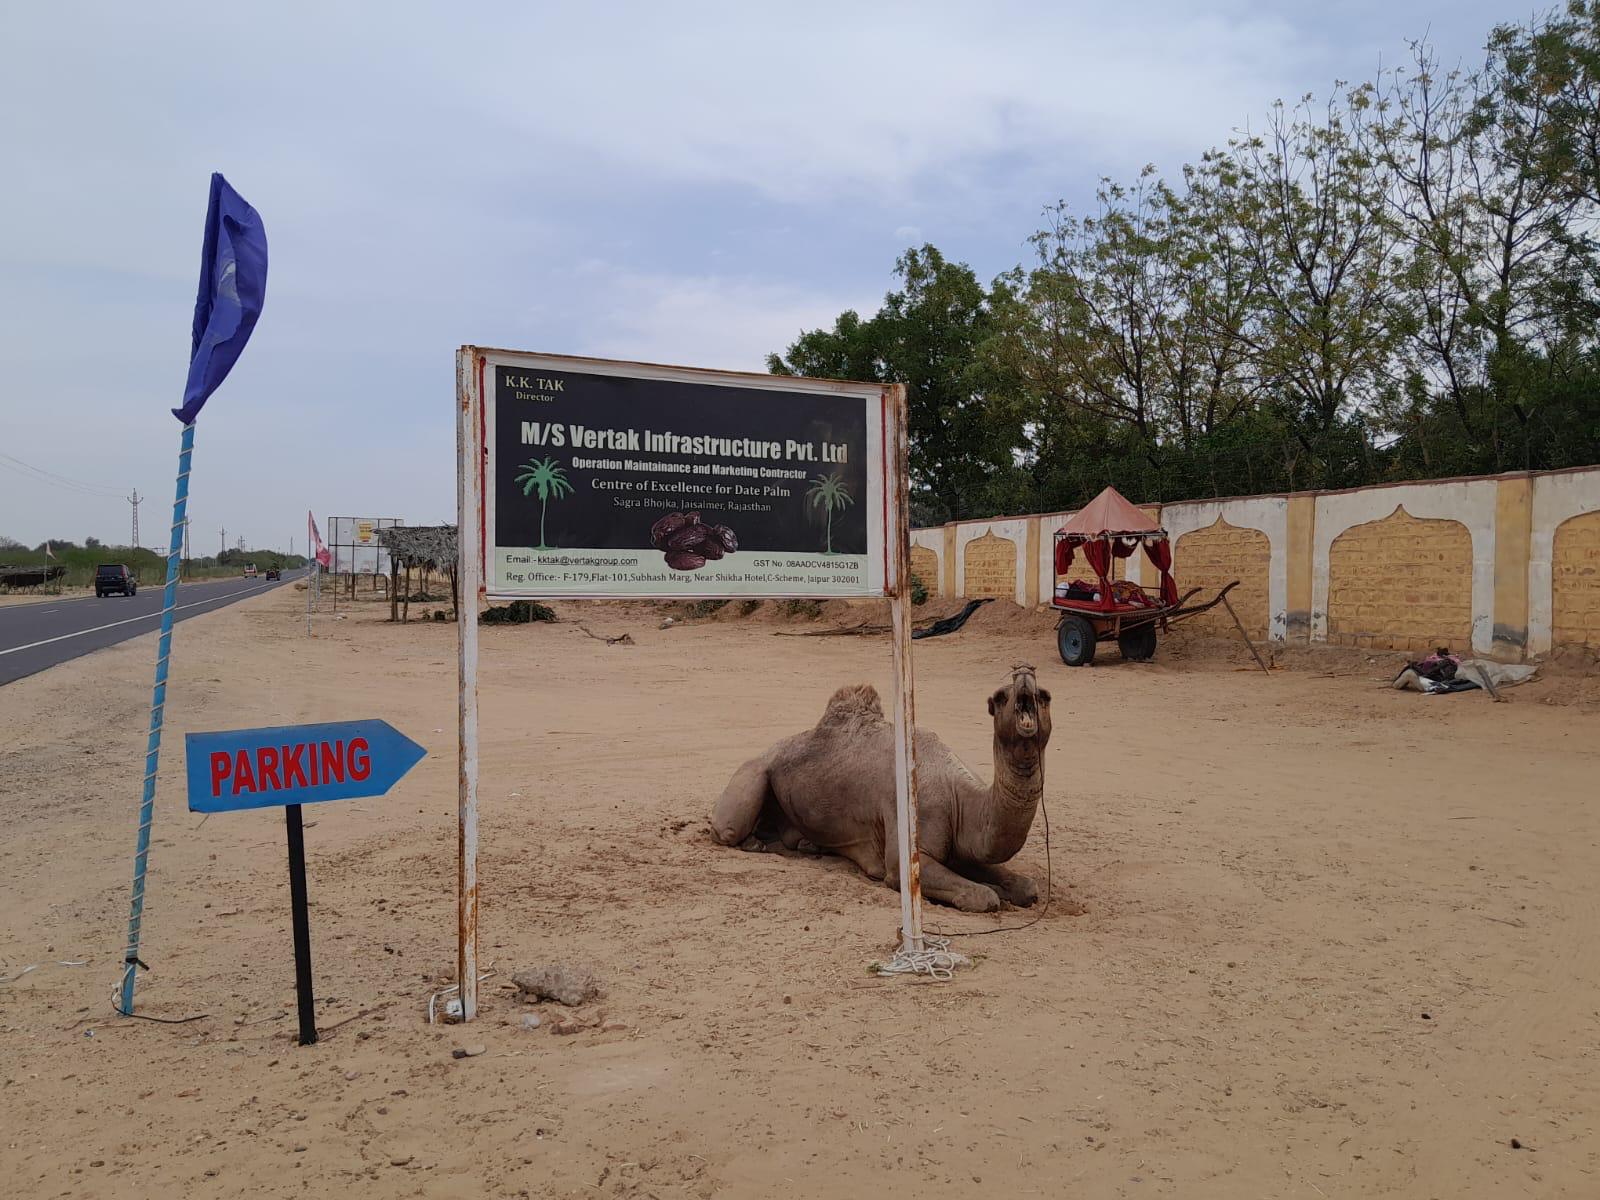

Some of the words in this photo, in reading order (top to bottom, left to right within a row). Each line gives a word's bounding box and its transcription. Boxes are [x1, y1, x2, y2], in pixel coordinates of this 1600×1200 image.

[506, 376, 532, 388] K.K.
[536, 378, 564, 391] TAK
[516, 392, 555, 402] Director
[522, 422, 565, 447] M/S
[570, 424, 640, 450] Vertak
[644, 430, 782, 460] Infrastructure
[786, 440, 818, 462] Pvt.
[822, 442, 848, 464] Ltd
[572, 456, 622, 470] Operation
[624, 460, 690, 474] Maintainance
[692, 464, 710, 474] and
[712, 464, 758, 478] Marketing
[760, 467, 806, 480] Contractor
[592, 478, 632, 490] Centre
[636, 480, 648, 490] of
[652, 481, 712, 493] Excellence
[716, 484, 732, 494] for
[736, 485, 760, 496] Date
[764, 486, 790, 496] Palm
[614, 497, 640, 508] Sagra
[644, 498, 678, 510] Bhojka,
[681, 500, 725, 510] Jaisalmer,
[728, 502, 771, 512] Rajasthan
[506, 572, 526, 582] Reg.
[669, 574, 692, 583] Marg,
[716, 574, 742, 582] Shikha
[808, 575, 829, 584] Jaipur
[210, 737, 372, 796] PARKING
